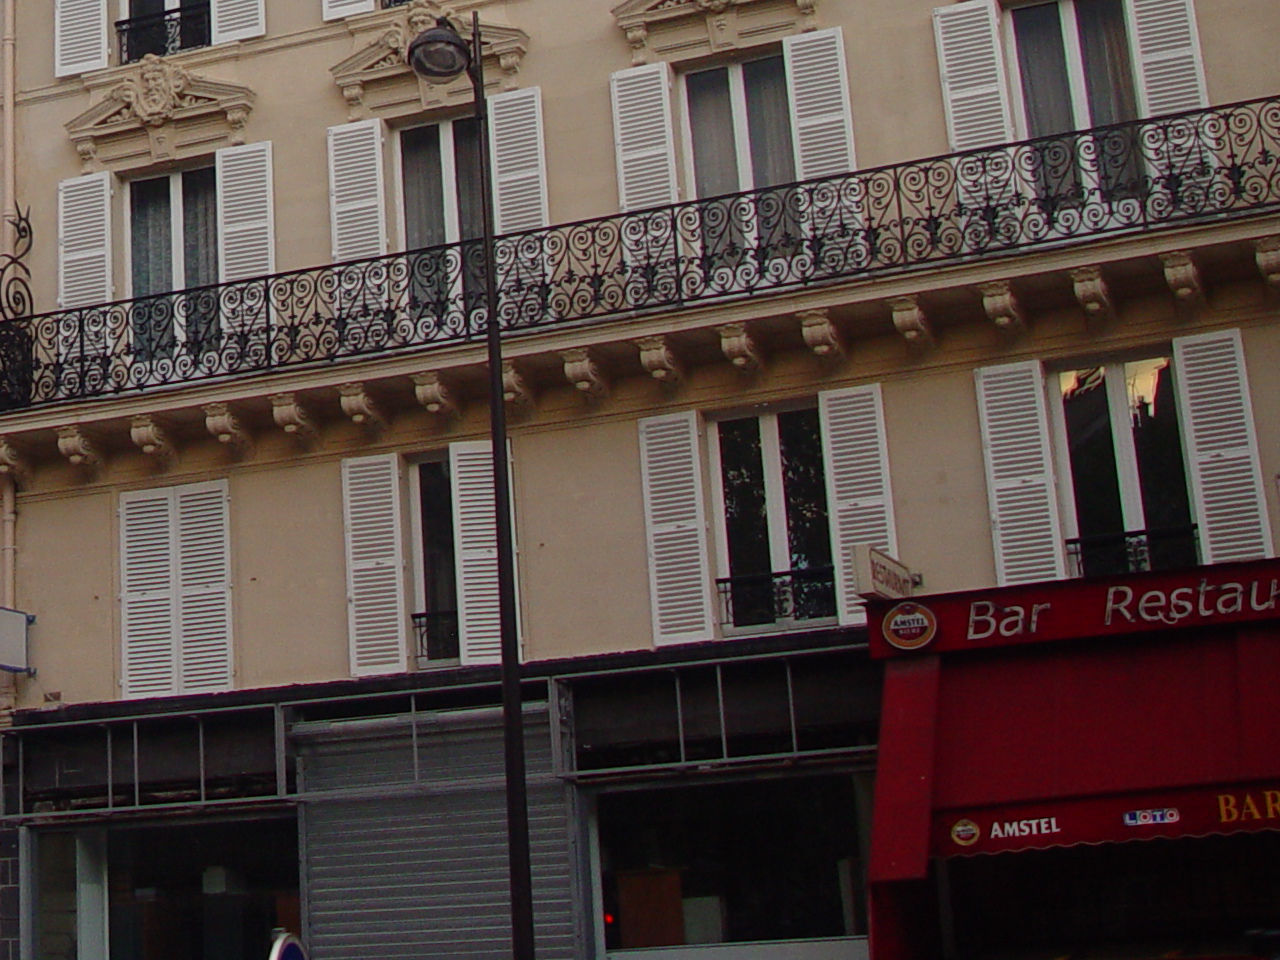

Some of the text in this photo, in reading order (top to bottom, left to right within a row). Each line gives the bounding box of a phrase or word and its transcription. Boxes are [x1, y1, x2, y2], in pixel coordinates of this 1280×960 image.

[893, 617, 925, 627] AMSTEL
[967, 577, 1280, 640] Bar Restau
[989, 790, 1280, 839] AMSTEL LOTO BAR
